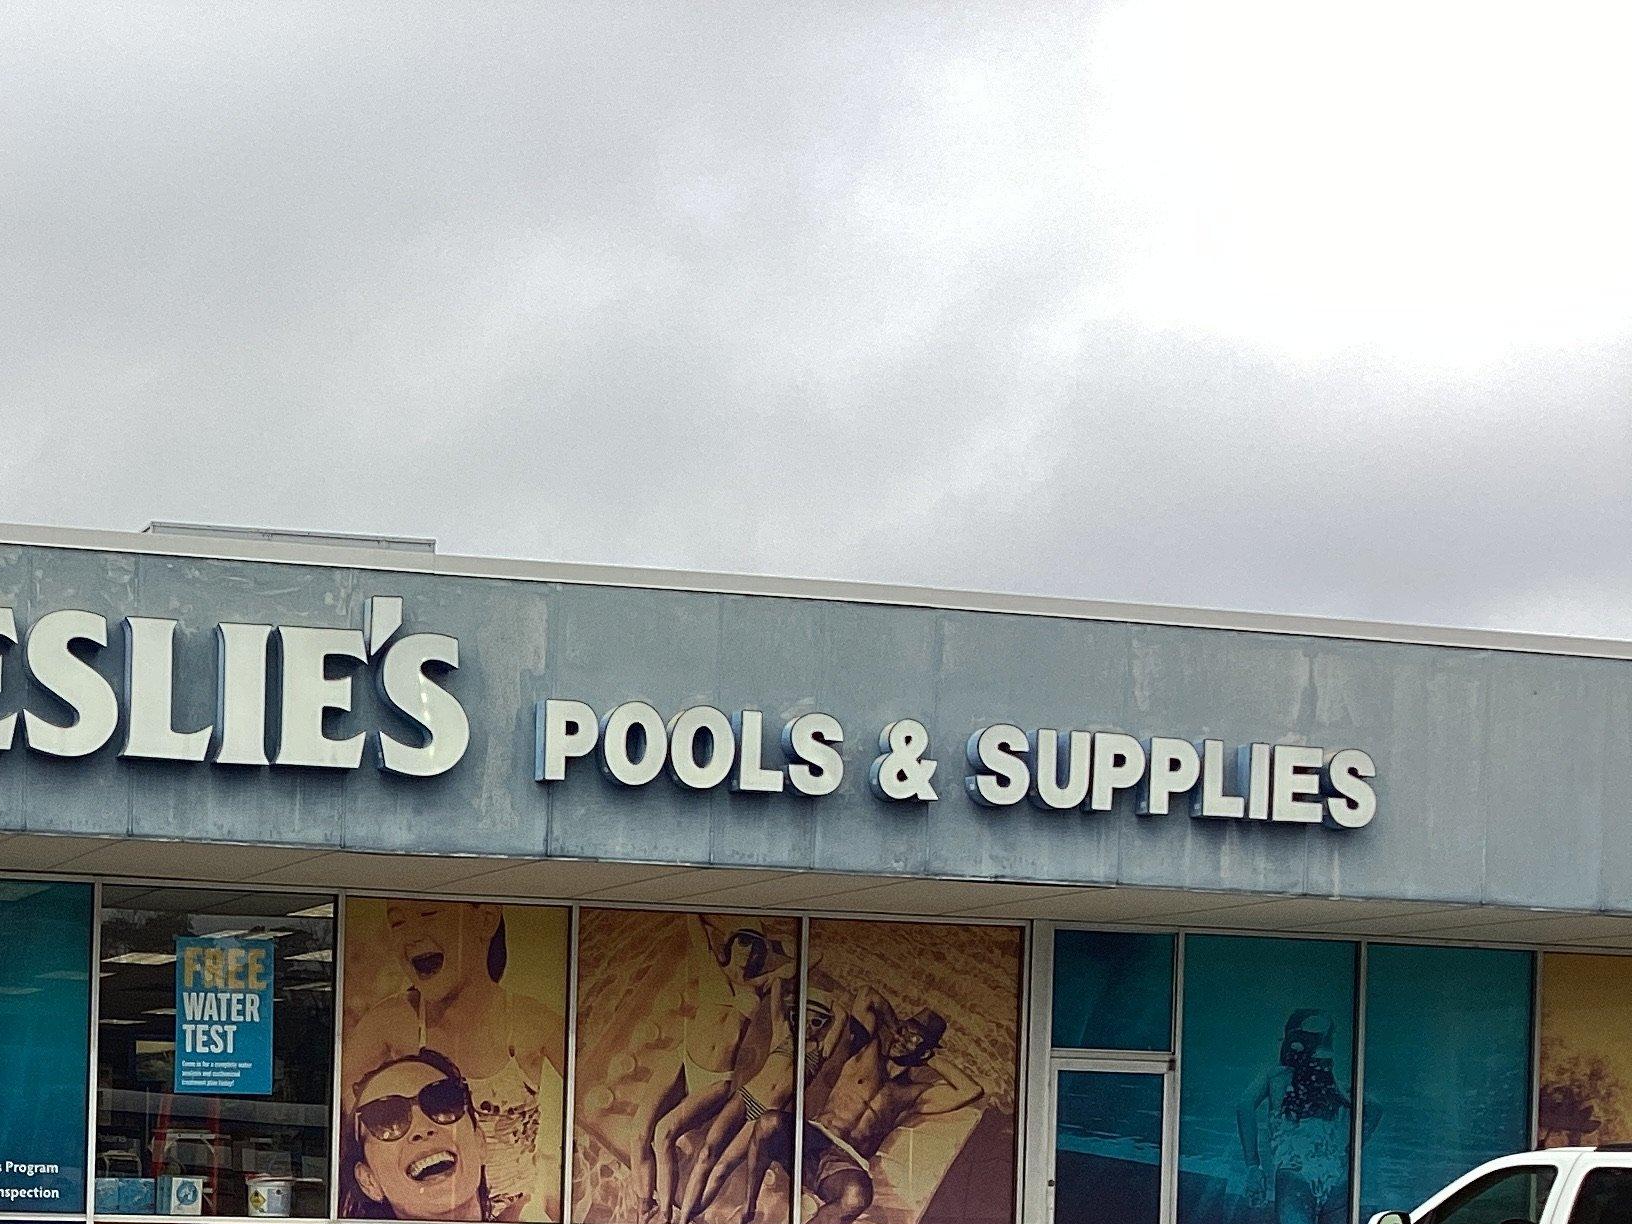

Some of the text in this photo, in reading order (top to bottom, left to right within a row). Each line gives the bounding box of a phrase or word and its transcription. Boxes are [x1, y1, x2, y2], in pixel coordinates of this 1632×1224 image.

[535, 698, 845, 796] POOLS
[870, 719, 939, 802] &
[966, 722, 1377, 829] SUPPLIES
[184, 946, 267, 989] FREE
[183, 992, 260, 1022] WATER
[182, 1024, 237, 1053] TEST
[5, 1161, 59, 1176] Program
